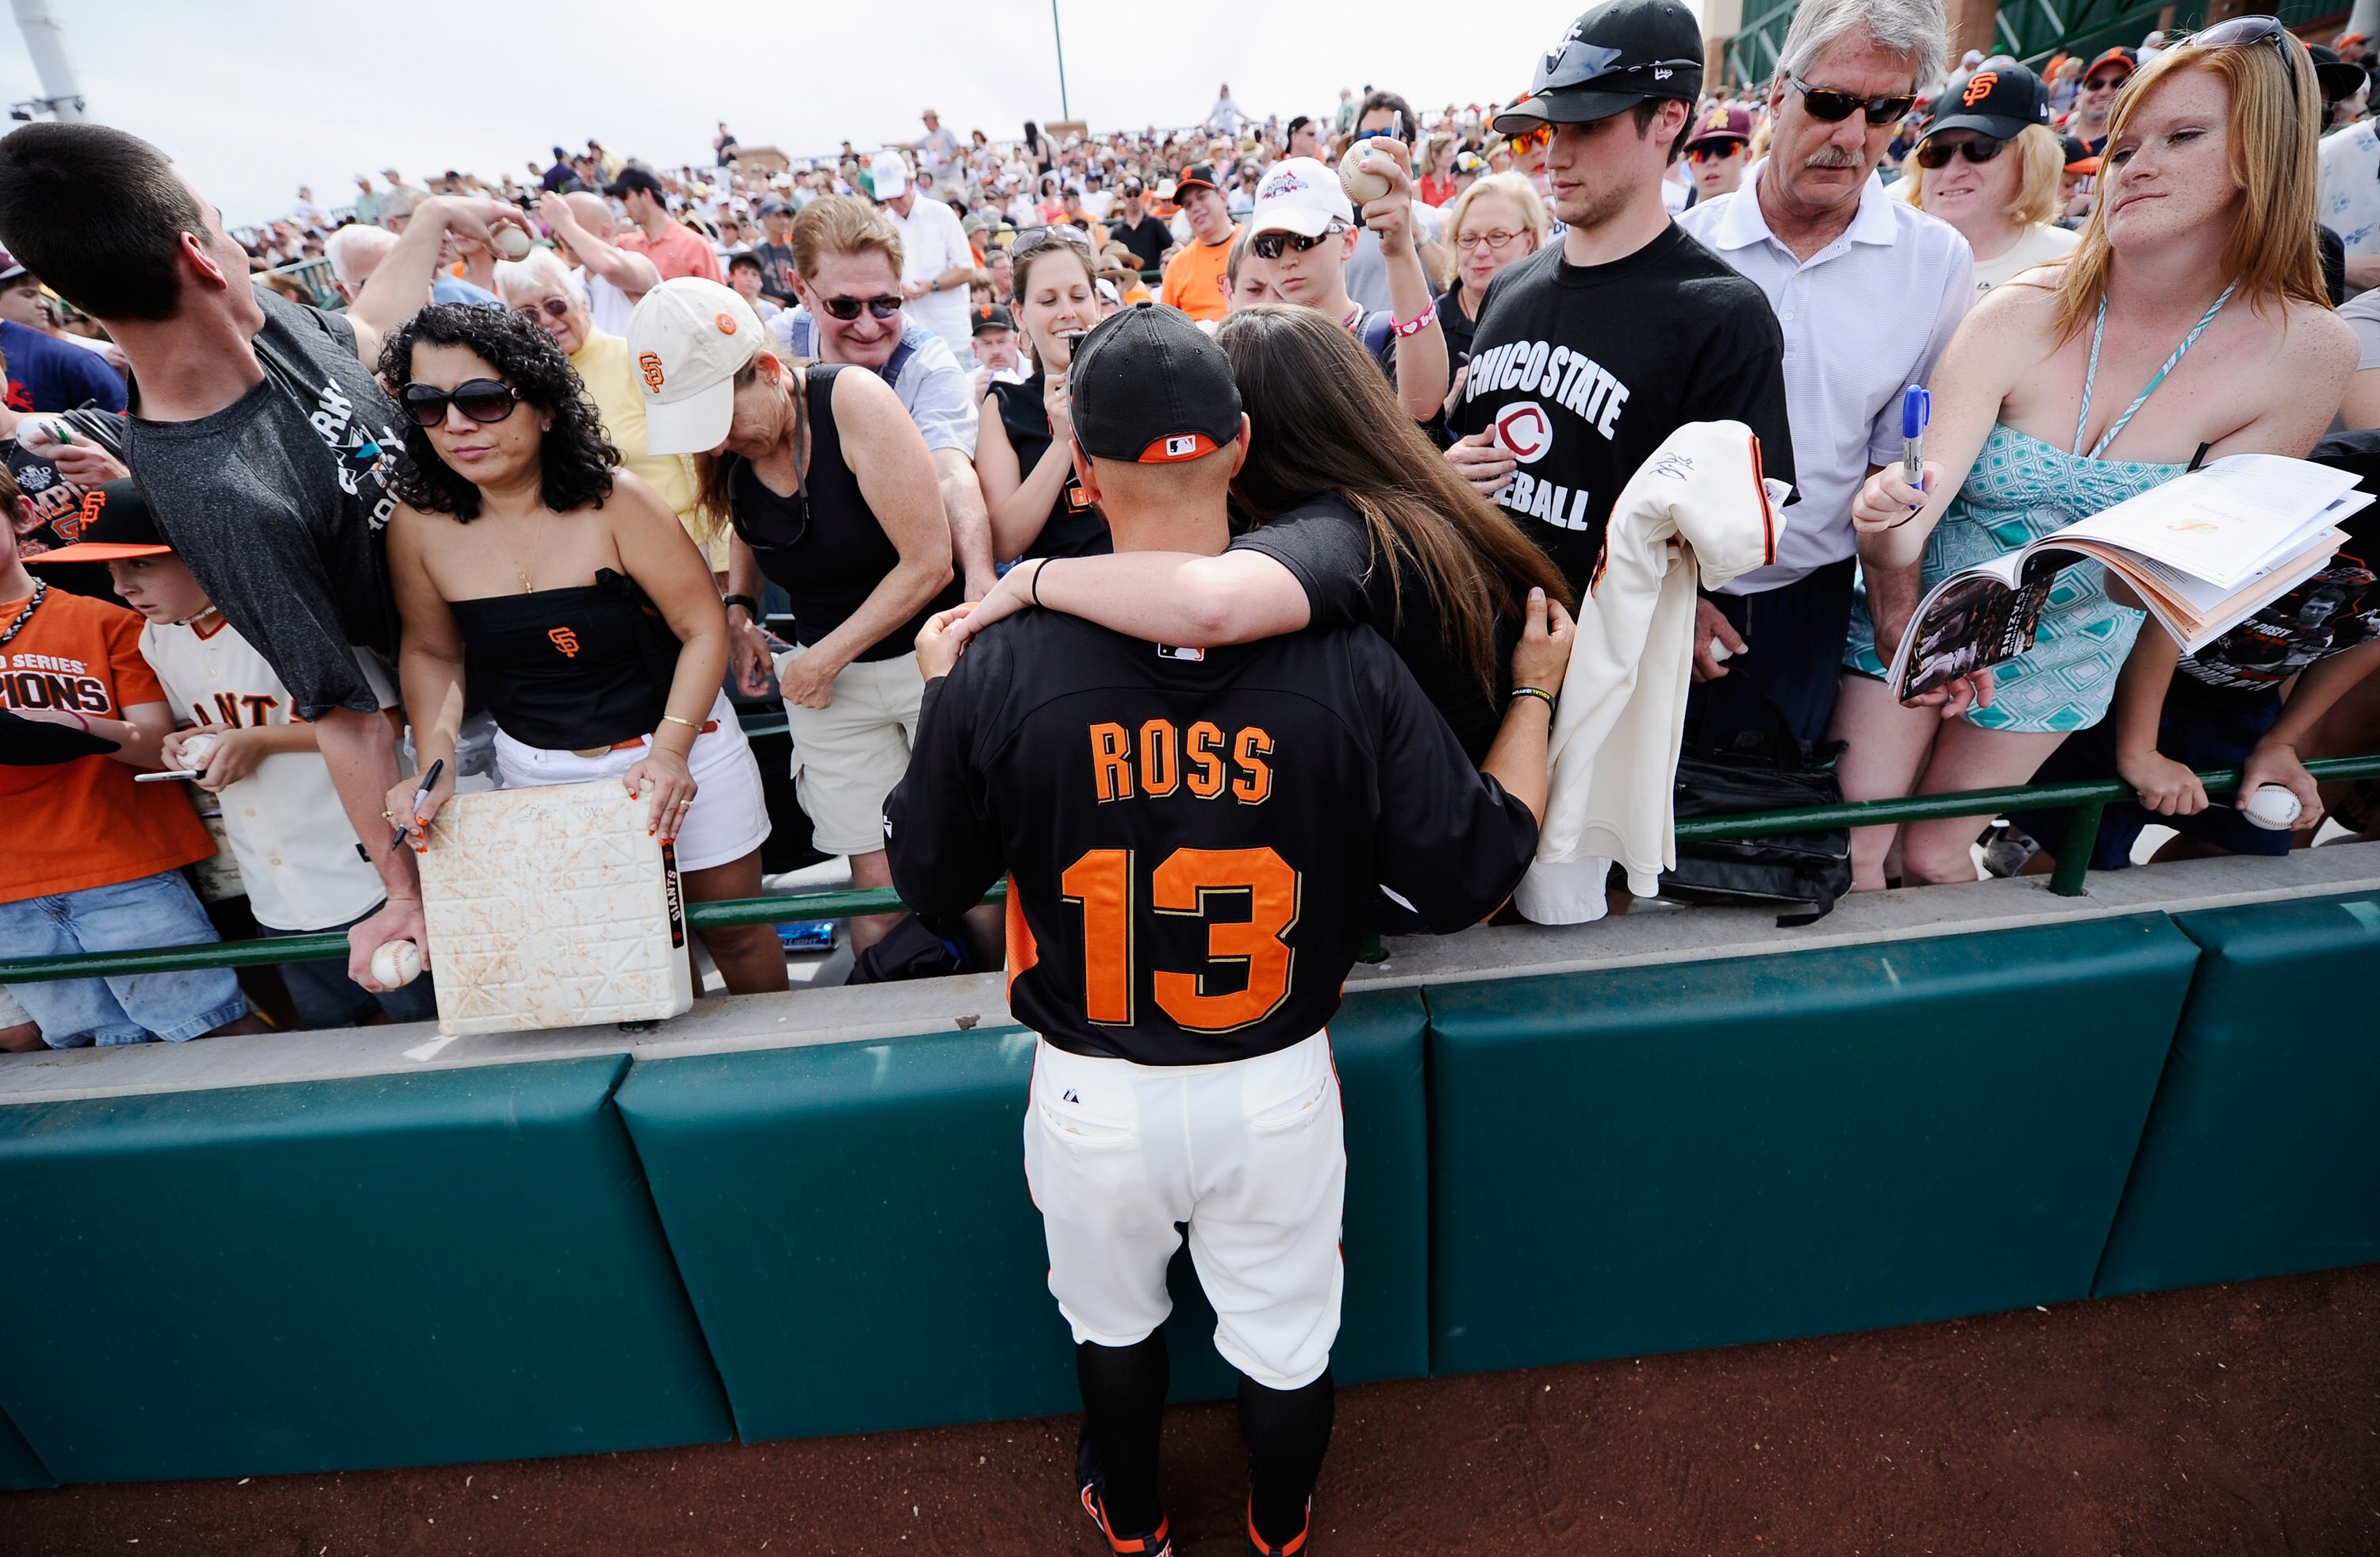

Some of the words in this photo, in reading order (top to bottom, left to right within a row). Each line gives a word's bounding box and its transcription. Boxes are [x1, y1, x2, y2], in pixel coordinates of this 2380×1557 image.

[1466, 340, 1549, 404] CHICO
[1540, 345, 1630, 441] STATE
[1493, 469, 1589, 531] EBALL
[2000, 585, 2029, 658] GAZINE
[0, 670, 111, 715] IONS
[13, 654, 86, 675] SERIES
[1088, 719, 1275, 805] ROSS
[667, 869, 681, 922] GIANTS
[1060, 846, 1303, 1034] 13
